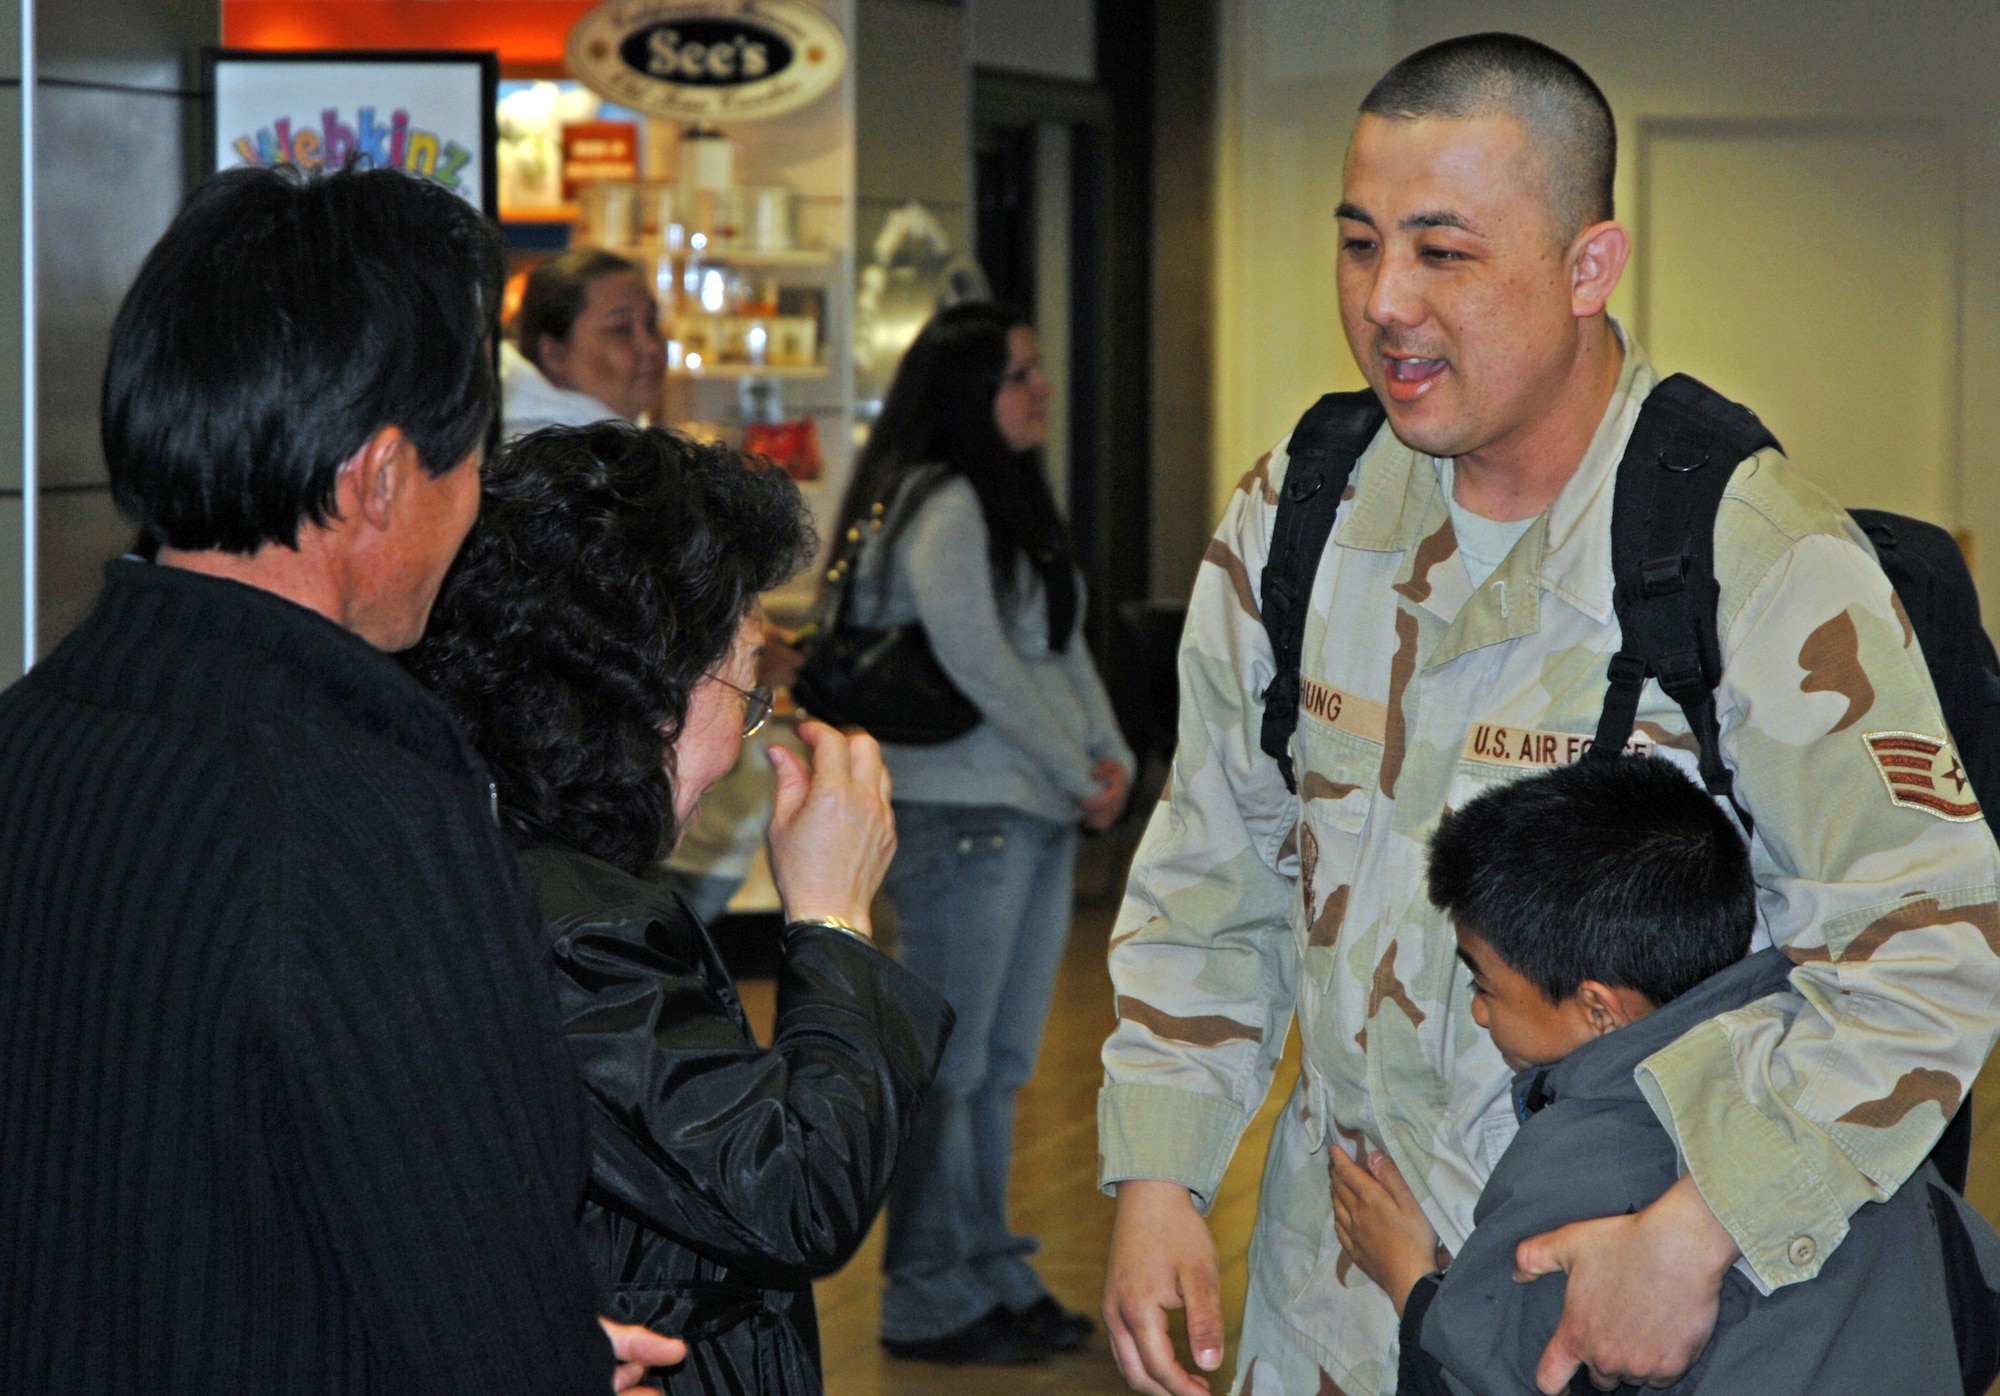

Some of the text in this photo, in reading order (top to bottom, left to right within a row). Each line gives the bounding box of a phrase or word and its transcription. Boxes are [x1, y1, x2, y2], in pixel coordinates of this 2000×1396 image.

[647, 29, 769, 78] See's
[233, 106, 472, 188] Webkinz
[1474, 725, 1511, 760] U.S.
[1519, 733, 1558, 764] AIR
